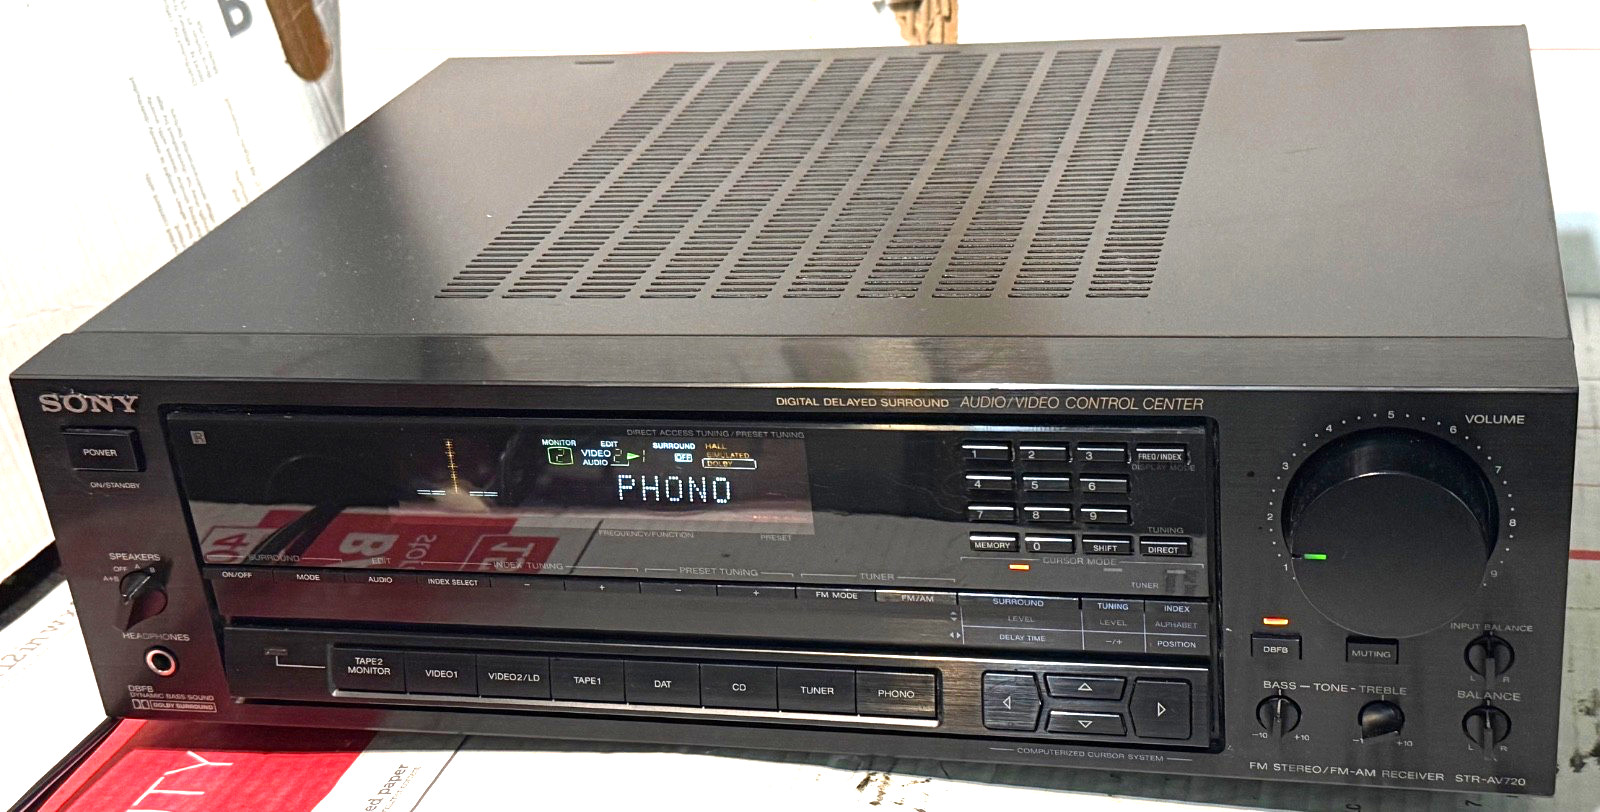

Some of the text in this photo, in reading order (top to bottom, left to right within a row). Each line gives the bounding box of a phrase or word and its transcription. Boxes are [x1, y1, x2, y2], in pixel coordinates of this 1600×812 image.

[39, 393, 138, 413] SONY
[776, 397, 949, 408] DIGITAL DELAYED SURROUND
[960, 396, 1204, 410] AUDIO/VIDEO CONTROL CENTER
[1387, 410, 1395, 419] 5
[1465, 414, 1525, 425] VOLUME
[1325, 424, 1333, 433] 4
[1449, 425, 1457, 434] 6
[627, 429, 659, 437] DIRECT
[696, 430, 729, 438] TUNING
[771, 431, 805, 439] TUNING
[542, 439, 577, 447] MONITOR
[652, 442, 696, 450] SURROUND
[83, 448, 118, 457] POWER
[556, 448, 565, 462] 2
[581, 449, 611, 457] VIDEO
[971, 450, 977, 458] 1
[1028, 451, 1035, 459] 2
[1085, 452, 1093, 460] 3
[675, 453, 692, 462] OFF
[1170, 464, 1196, 472] MODE
[1282, 462, 1289, 470] 3
[1495, 466, 1502, 474] 7
[90, 481, 141, 489] ON/STANDBY
[974, 480, 982, 488] 4
[1031, 481, 1039, 490] 5
[1088, 482, 1096, 491] 6
[618, 474, 731, 504] PHONO
[977, 511, 983, 519] 7
[1032, 511, 1040, 520] 8
[1089, 512, 1097, 520] 9
[1267, 512, 1274, 521] 2
[1509, 518, 1517, 527] 8
[1148, 526, 1184, 534] TUNING
[761, 534, 792, 542] PRESET
[974, 541, 1011, 550] MEMORY
[1033, 542, 1041, 551] 0
[1093, 544, 1118, 552] SHIFT
[1148, 546, 1179, 554] DIRECT
[109, 552, 161, 561] SPEAKERS
[249, 552, 301, 563] SURROUND
[372, 556, 391, 565] EDIT
[493, 561, 564, 570] INDEX TUNING
[1043, 557, 1117, 567] CURSOR MODE
[679, 566, 759, 577] PRESET TUNING
[1283, 564, 1288, 572] 1
[222, 571, 252, 579] ON/OFF
[296, 573, 321, 581] MODE
[859, 572, 895, 581] TUNER
[1490, 569, 1498, 578] 9
[367, 576, 393, 584] AUDIO
[427, 578, 478, 587] INDEX SELECT
[1131, 581, 1159, 589] TUNER
[815, 591, 859, 600] FM MODE
[901, 594, 934, 603] FM/AM
[992, 598, 1044, 607] SURROUND
[1097, 602, 1129, 611] TUNING
[1164, 605, 1190, 613] INDEX
[1007, 615, 1035, 623] LEVEL
[1099, 619, 1127, 627] LEVEL
[1155, 621, 1198, 630] ALPHABET
[1450, 622, 1533, 632] INPUT BALANCE
[122, 632, 191, 642] HEADPHONES
[999, 634, 1046, 643] DELAY TIME
[1157, 640, 1197, 649] POSITION
[1263, 646, 1289, 654] DBFB
[1351, 649, 1392, 659] MUTING
[354, 657, 383, 666] TAPE2
[348, 666, 391, 676] MONITOR
[425, 669, 459, 679] VIDEO1
[488, 672, 540, 683] VIDEO2/LD
[573, 675, 602, 686] TAPE1
[128, 684, 154, 693] DBFB
[654, 679, 672, 689] DAT
[732, 682, 747, 692] CD
[1263, 680, 1407, 696] BASS TONE TREBLE
[800, 685, 834, 696] TUNER
[878, 689, 915, 700] PHONO
[130, 692, 215, 702] DYNAMIC BASS SOUND
[1457, 690, 1521, 701] BALANCE
[175, 703, 214, 711] SURROUND
[1017, 746, 1164, 762] COMPUTERIZED CURSOR SYSTEM
[1249, 761, 1268, 771] FM
[1381, 770, 1444, 782] RECEIVER
[1455, 774, 1526, 787] STR-AV720
[378, 763, 408, 795] paper
